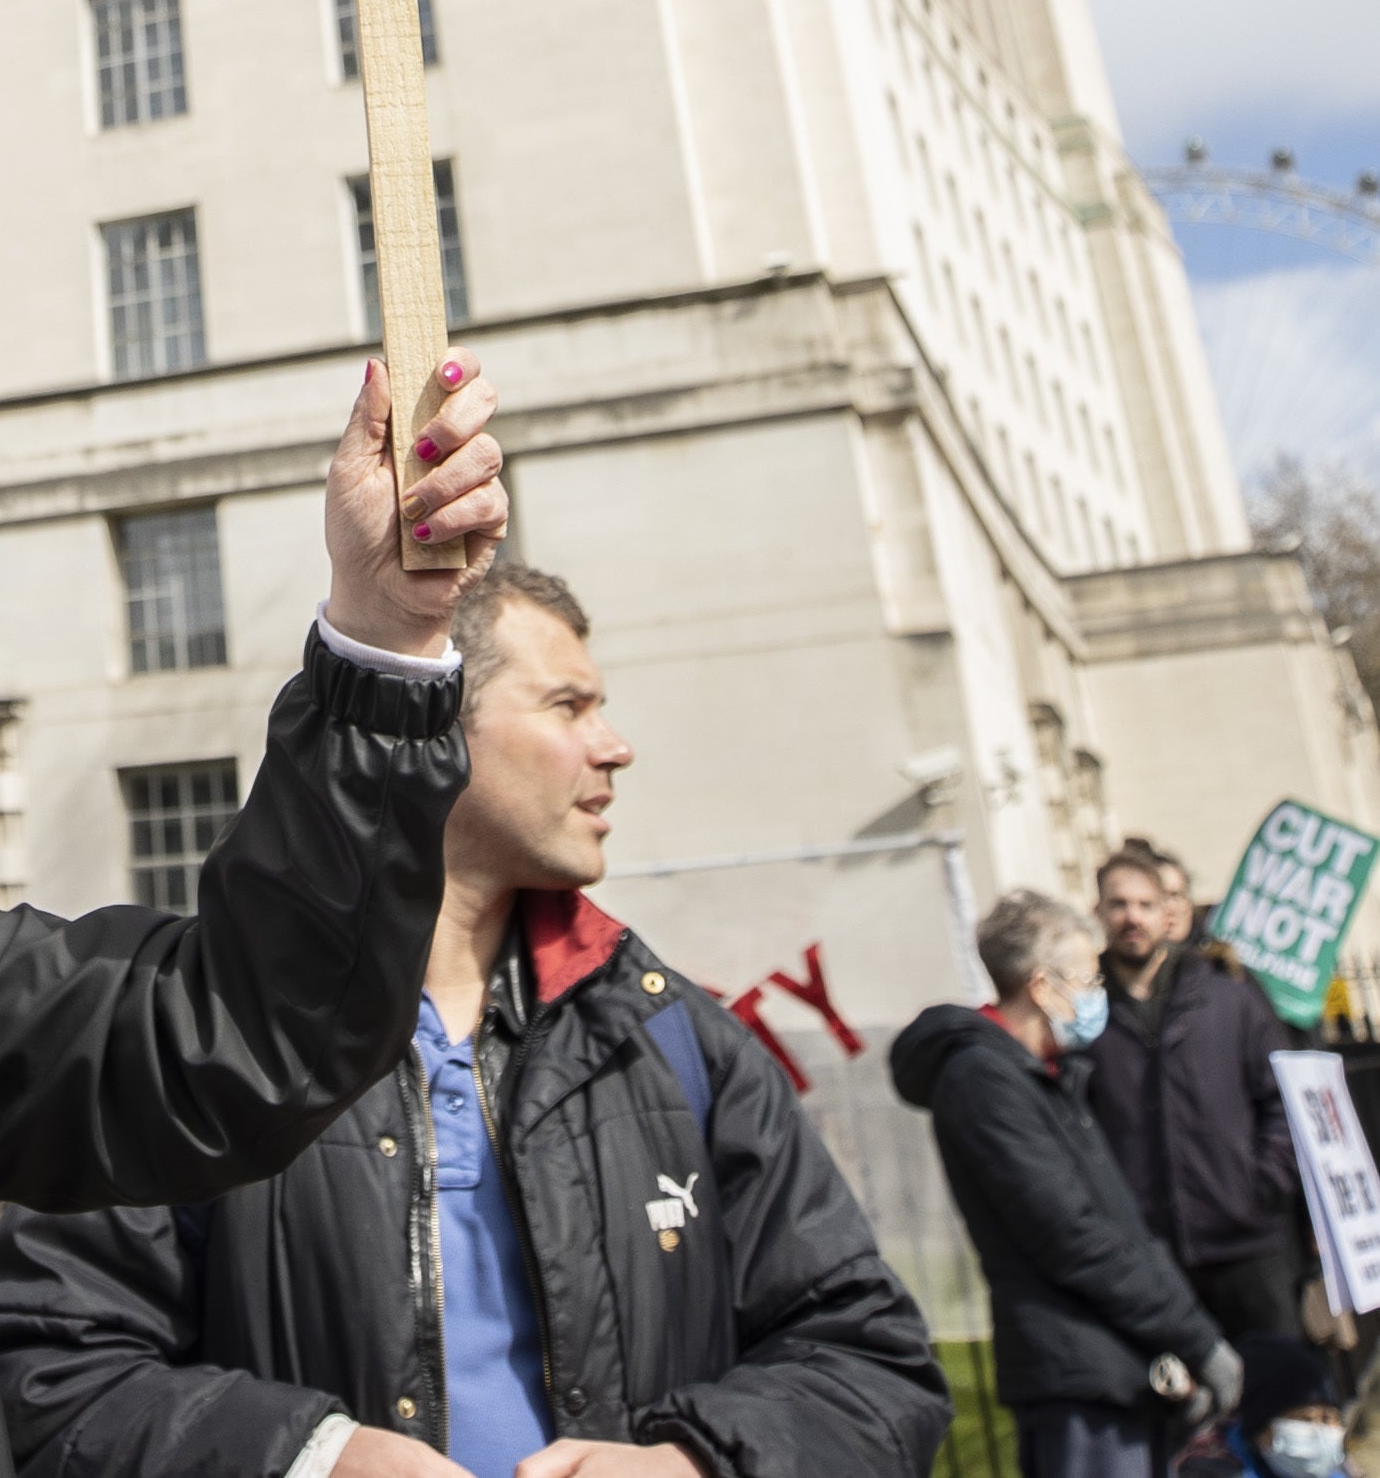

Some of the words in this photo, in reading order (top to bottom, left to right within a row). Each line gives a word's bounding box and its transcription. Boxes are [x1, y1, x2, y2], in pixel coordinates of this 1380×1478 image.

[1261, 800, 1374, 877] CUT
[1243, 843, 1356, 923] WAR
[1223, 884, 1339, 965] NOT
